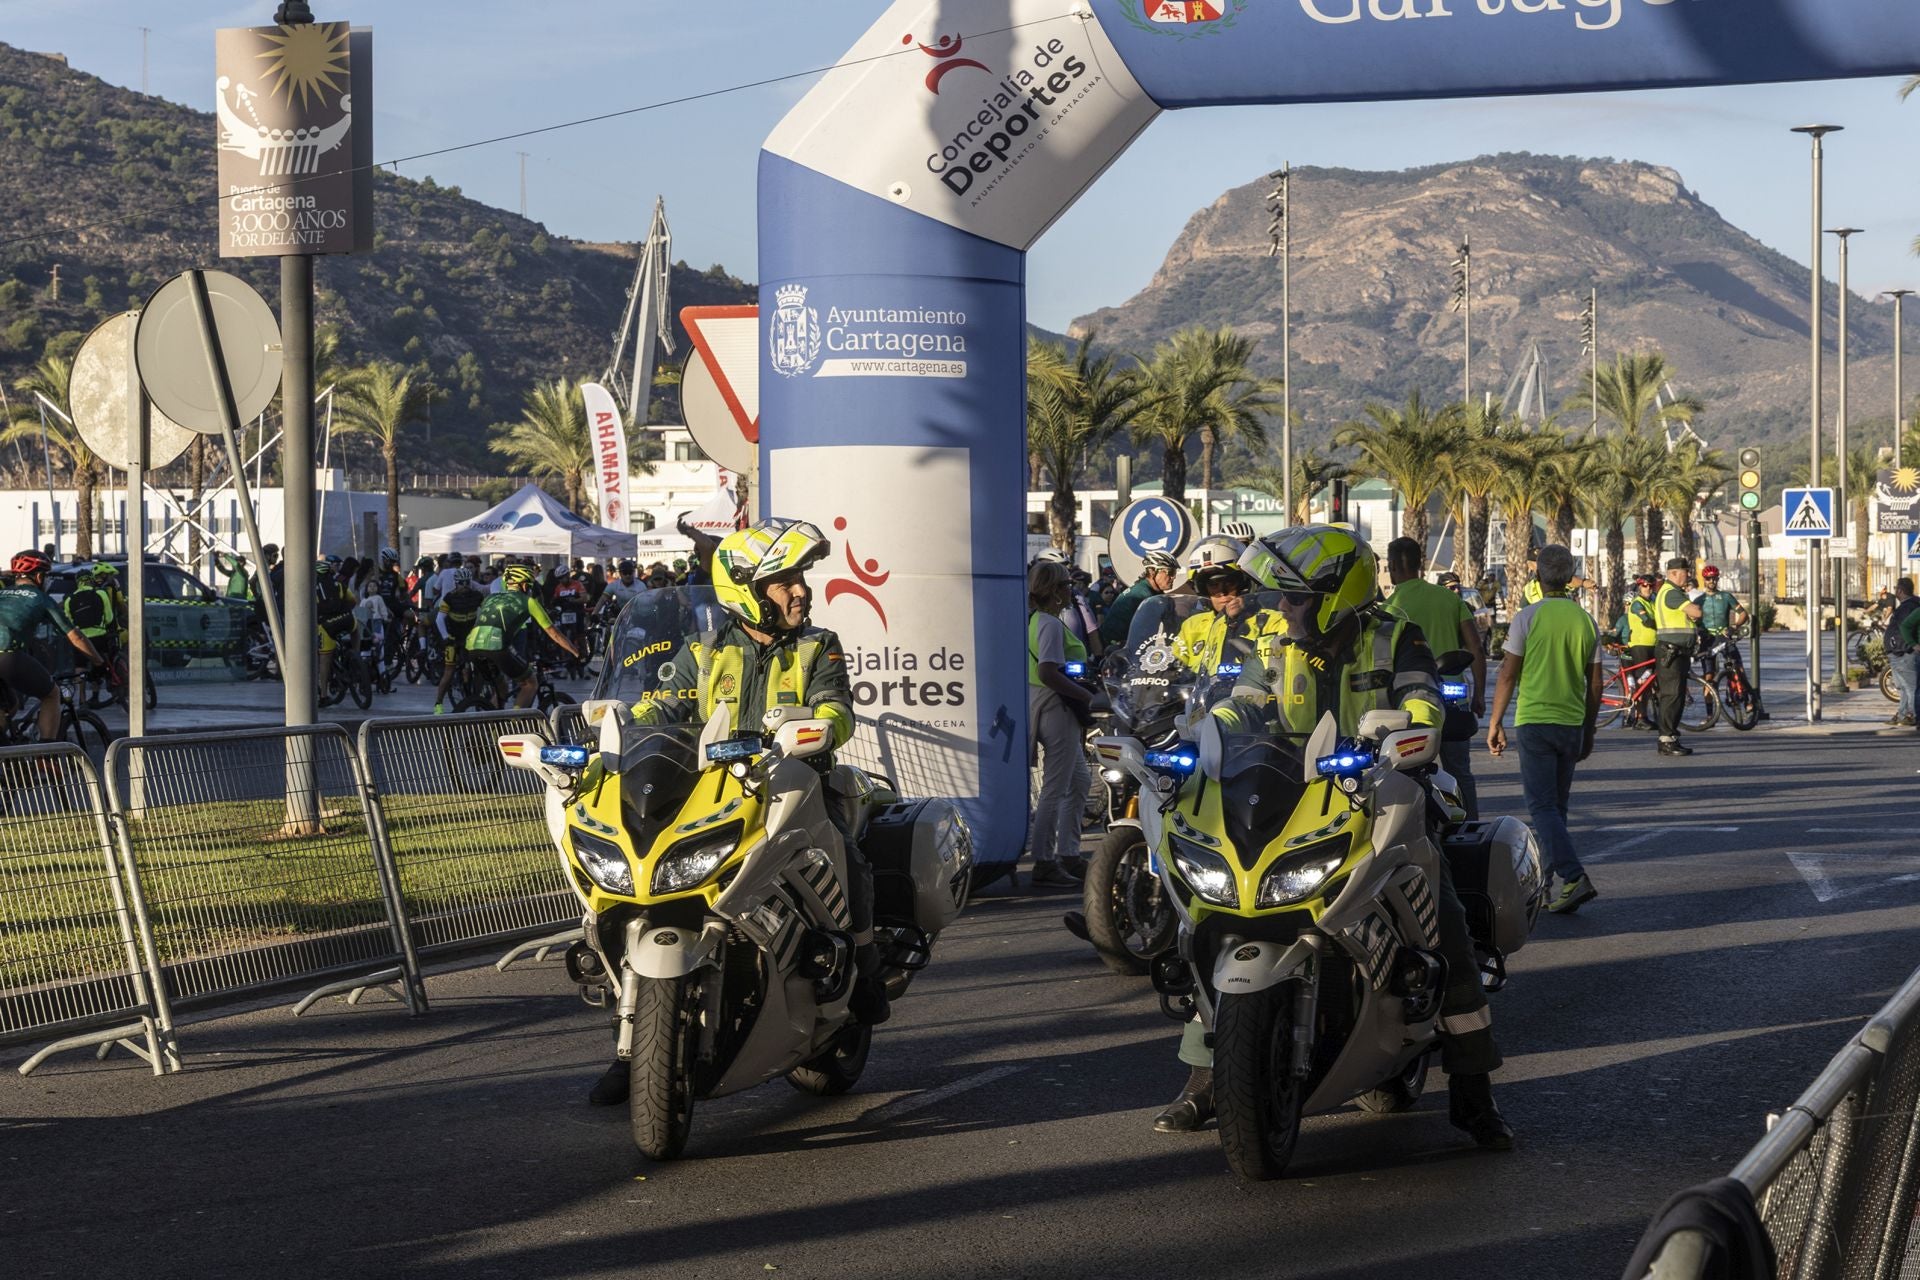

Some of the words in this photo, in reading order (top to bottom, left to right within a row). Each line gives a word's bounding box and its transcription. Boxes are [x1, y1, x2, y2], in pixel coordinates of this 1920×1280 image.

[926, 68, 1034, 174] Concejalía
[1033, 38, 1064, 68] de
[940, 55, 1086, 197] Deportes
[971, 142, 1035, 207] AYUNTAMIENTO
[1037, 127, 1049, 141] DE
[1051, 75, 1102, 126] CARTAGENA
[230, 184, 264, 195] Puerto
[266, 182, 281, 194] de
[230, 194, 316, 214] Cartagena
[229, 212, 290, 236] 3.000
[292, 208, 347, 231] AÑOS
[230, 232, 259, 248] POR
[261, 230, 325, 246] DELANTE
[827, 306, 966, 326] Ayuntamiento
[826, 327, 966, 357] Cartagena
[850, 360, 963, 375] www.cartagena.es
[928, 646, 965, 671] de
[1130, 677, 1170, 687] TRAFICO
